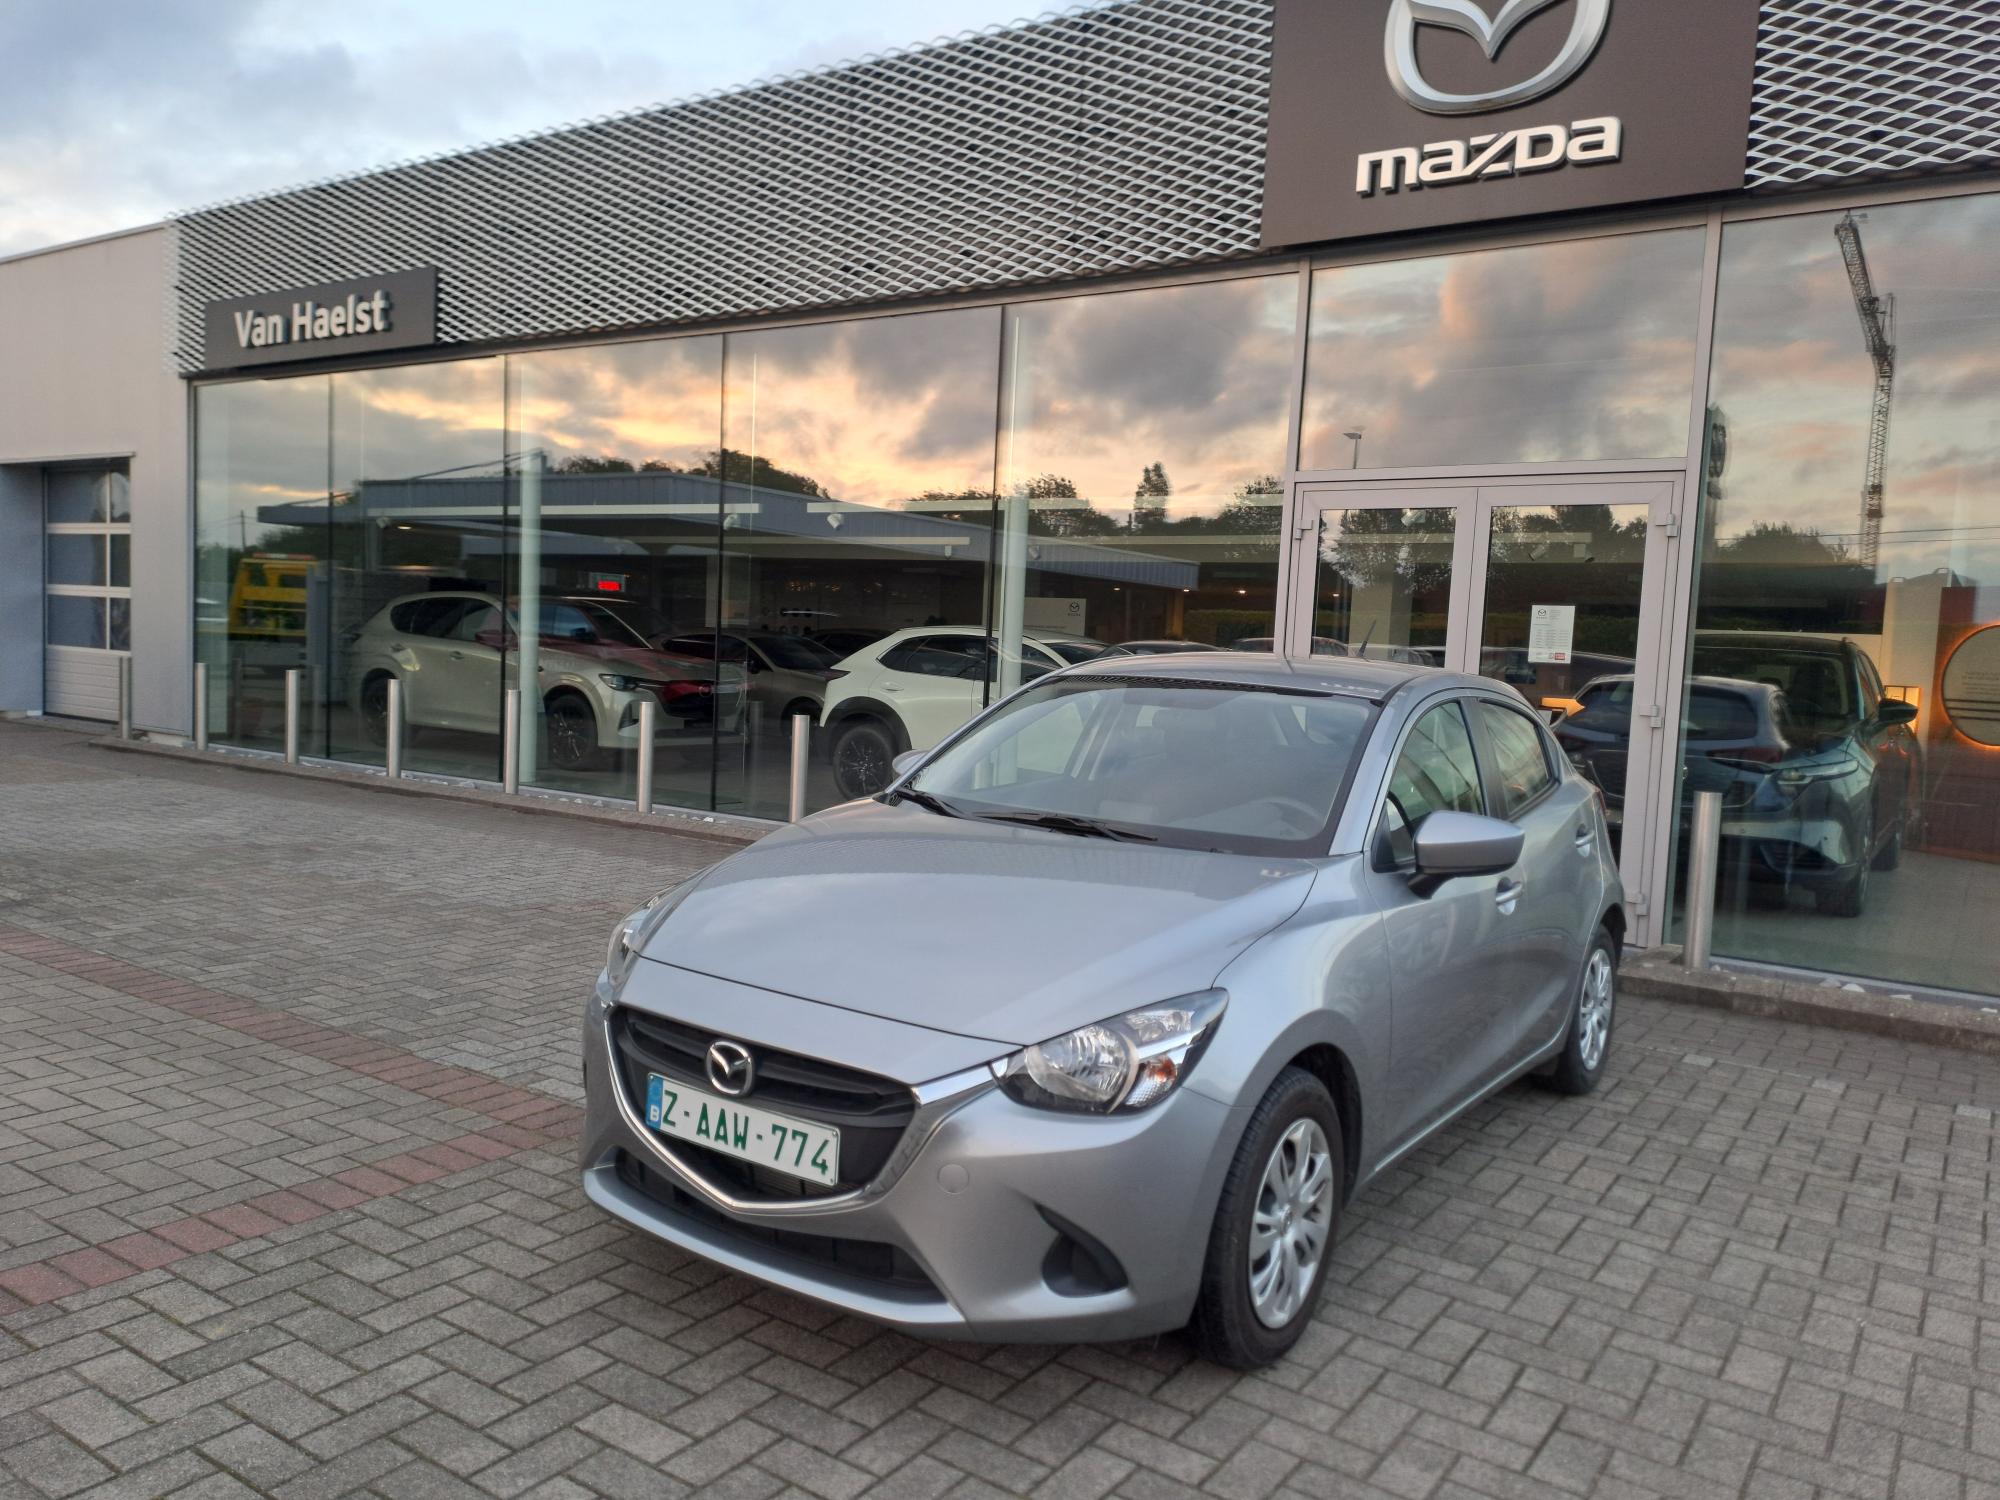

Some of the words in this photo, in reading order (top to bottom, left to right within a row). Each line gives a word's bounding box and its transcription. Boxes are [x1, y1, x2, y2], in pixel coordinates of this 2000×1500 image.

[1355, 116, 1621, 195] mazda
[234, 309, 284, 348] Van
[292, 289, 392, 341] Haelst
[650, 1105, 660, 1121] B
[662, 1090, 830, 1176] Z-AAW-774
